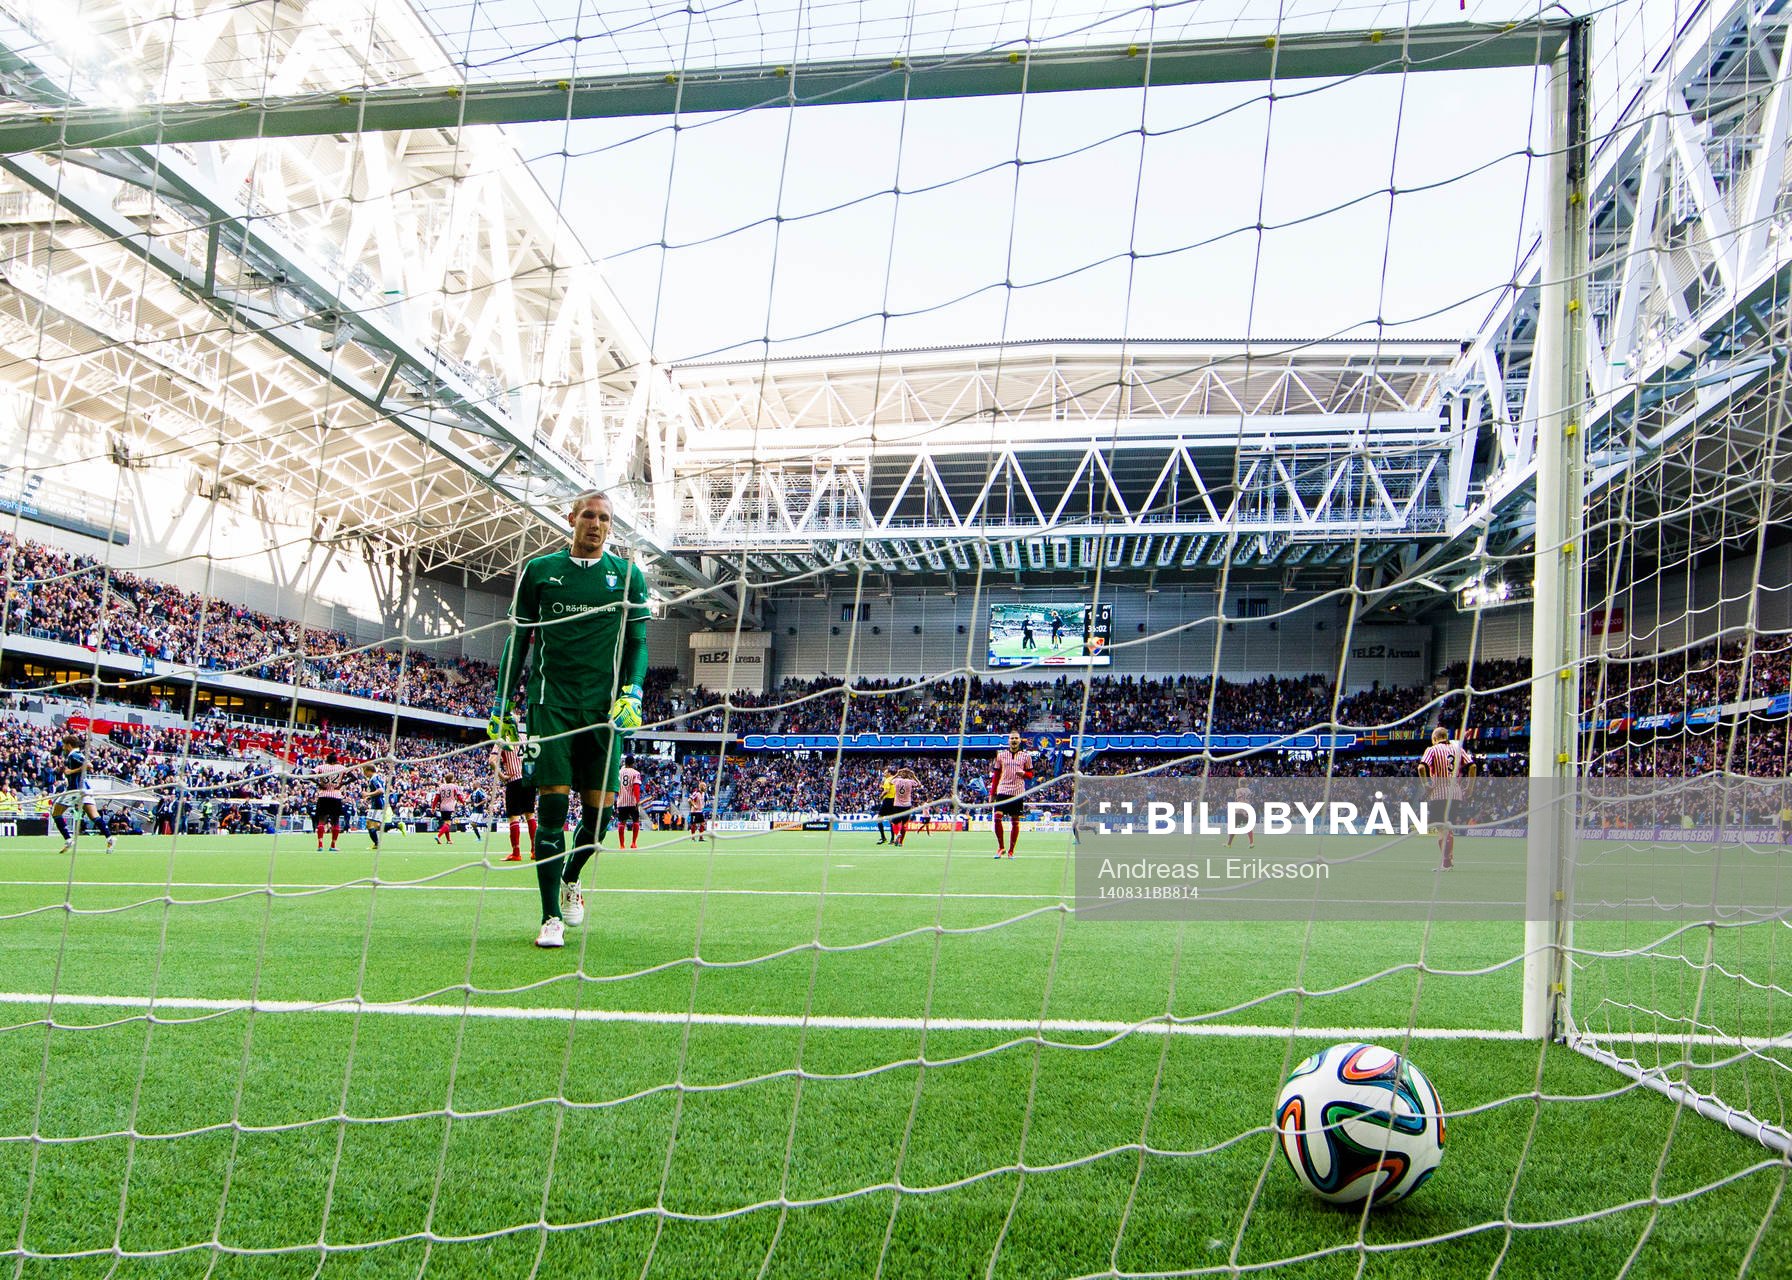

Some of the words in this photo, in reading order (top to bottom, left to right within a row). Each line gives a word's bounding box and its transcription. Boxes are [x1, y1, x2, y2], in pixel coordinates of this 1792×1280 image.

[699, 651, 729, 664] TELE2
[731, 655, 761, 664] rena
[1352, 645, 1385, 659] TELE2
[1387, 649, 1421, 659] Arena
[1070, 732, 1317, 750] DJURGÅRDENS
[1319, 734, 1356, 749] IF
[1447, 754, 1456, 773] 3
[622, 775, 629, 787] 8
[899, 785, 906, 795] 6
